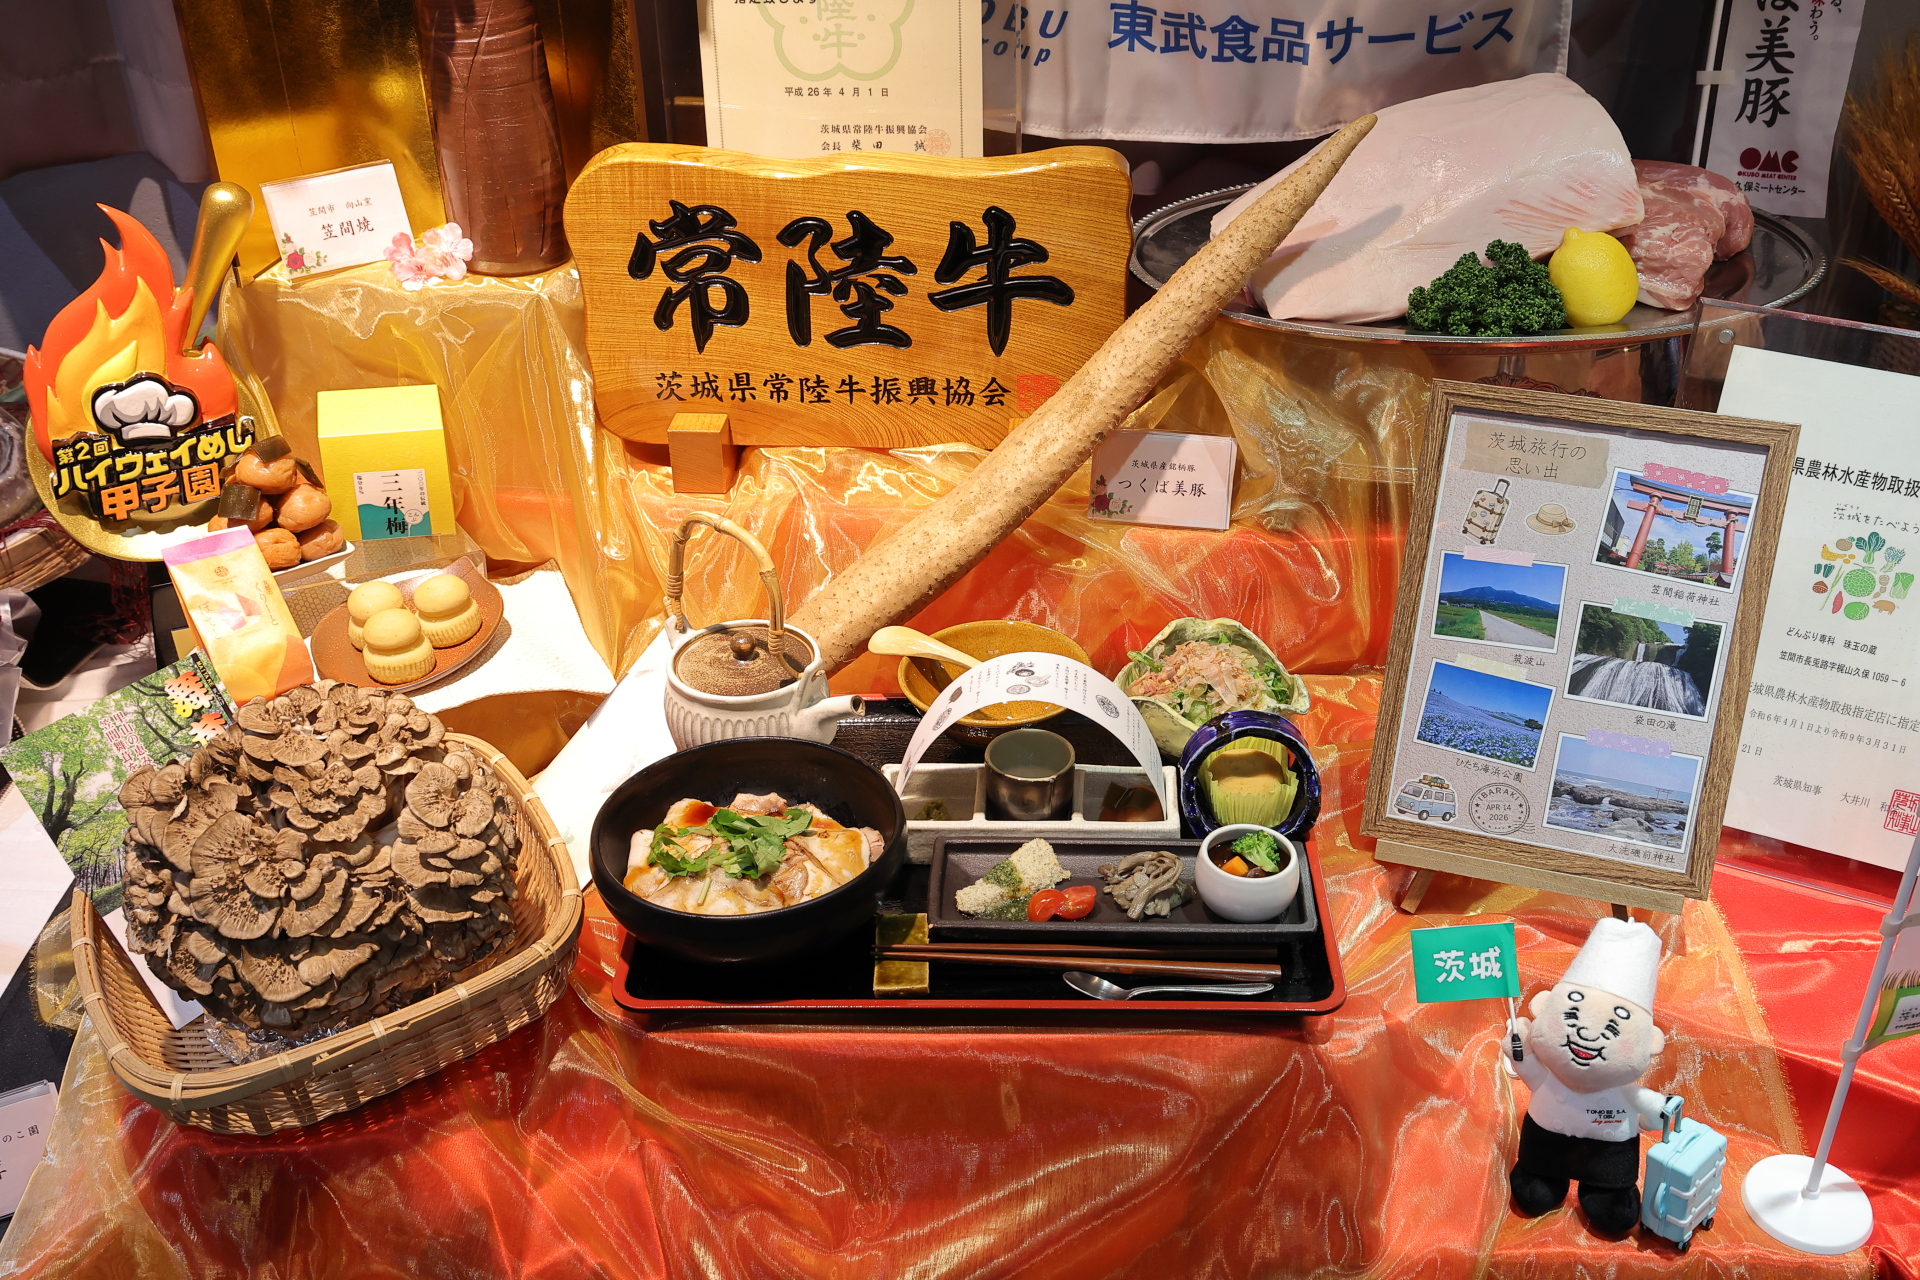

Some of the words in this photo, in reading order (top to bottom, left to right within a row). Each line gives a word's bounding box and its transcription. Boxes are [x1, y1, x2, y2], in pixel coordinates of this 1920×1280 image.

[1107, 1, 1514, 66] 東武食品サービス
[820, 124, 928, 135] 茨城県常陸牛振興協会
[321, 216, 375, 241] 笠間焼
[627, 199, 1076, 357] 常陸牛
[654, 371, 1012, 407] 茨城県常陸牛振興協会
[56, 440, 110, 466] 第2回
[1487, 431, 1588, 462] 茨城旅行の
[58, 428, 253, 496] ハイウェイめし
[1504, 457, 1559, 480] 思い出
[100, 462, 221, 521] 甲子園
[1118, 478, 1208, 498] つくば美豚
[1651, 583, 1720, 607] 笠間稲荷神社
[1786, 626, 1836, 646] どんぶり専科
[1513, 653, 1546, 668] 筑波山
[1633, 714, 1677, 732] 袋田の滝
[1455, 757, 1524, 783] ひたち海浜公園
[1477, 787, 1520, 802] IBARAKI
[1773, 774, 1823, 796] 茨城県知事
[1840, 791, 1871, 809] 大井川
[1486, 803, 1501, 811] APR
[1489, 813, 1509, 821] 2026
[1608, 843, 1676, 864] 大洗磯前神社
[1432, 945, 1503, 984] 茨城
[2, 1124, 40, 1143] のこ園
